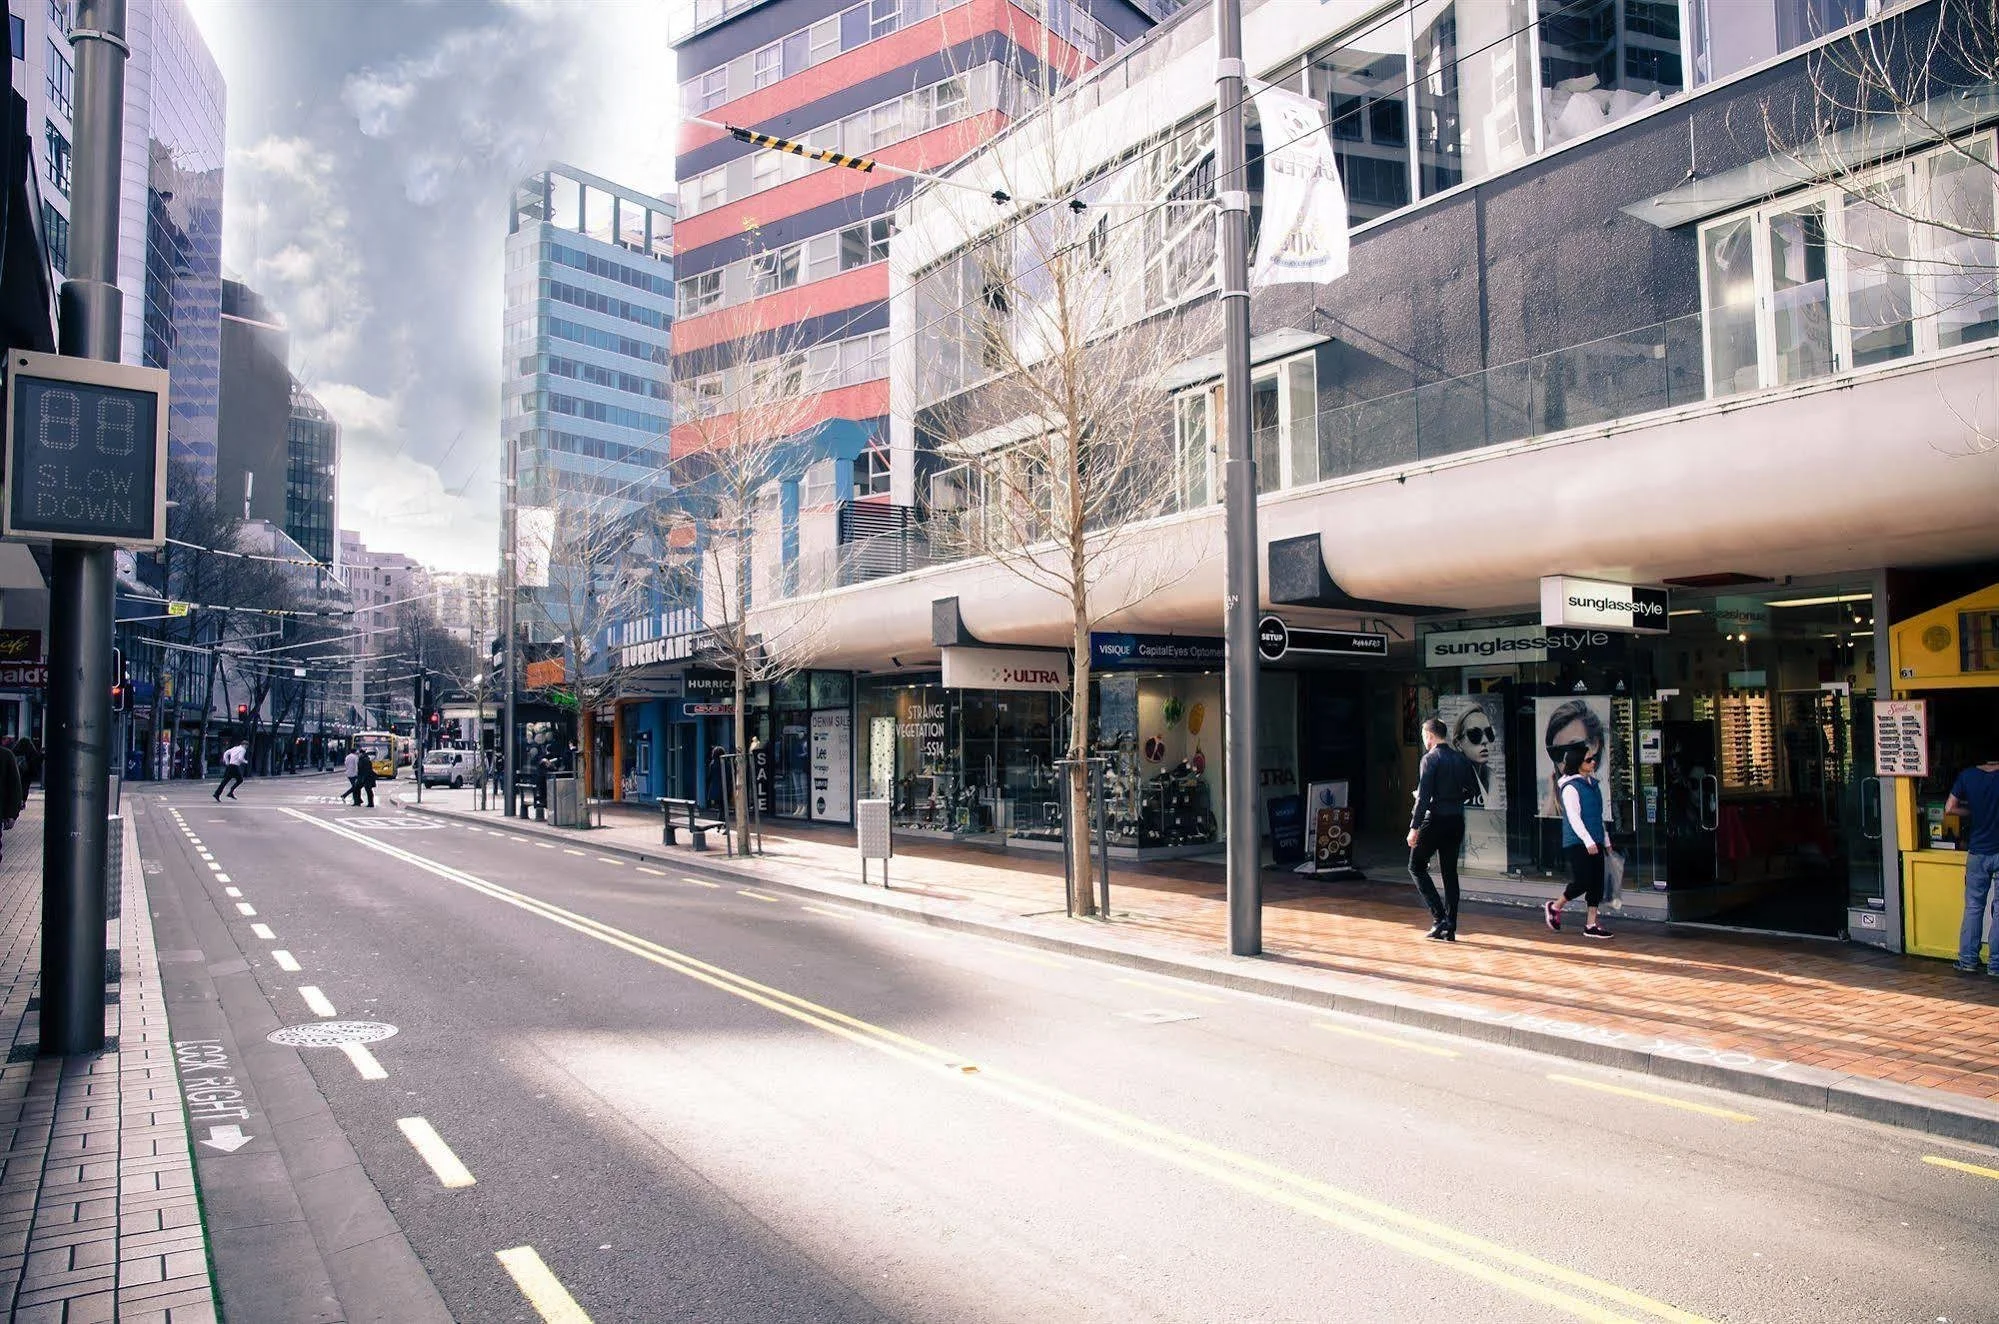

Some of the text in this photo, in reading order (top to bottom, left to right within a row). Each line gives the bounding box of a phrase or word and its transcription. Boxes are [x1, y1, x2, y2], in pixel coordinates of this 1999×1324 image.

[38, 464, 134, 495] SLOW
[37, 492, 131, 523] DOWN
[1261, 633, 1283, 641] SETUP
[622, 634, 693, 668] HURRICANE
[1099, 644, 1131, 656] VISIQUE
[1138, 645, 1188, 657] CapitalEyes
[1013, 668, 1060, 684] ULTRA
[908, 704, 945, 720] STRANGE
[895, 722, 945, 738] VEGETATION
[756, 752, 768, 811] SALE
[174, 1038, 250, 1120] LOOK RIGHT
